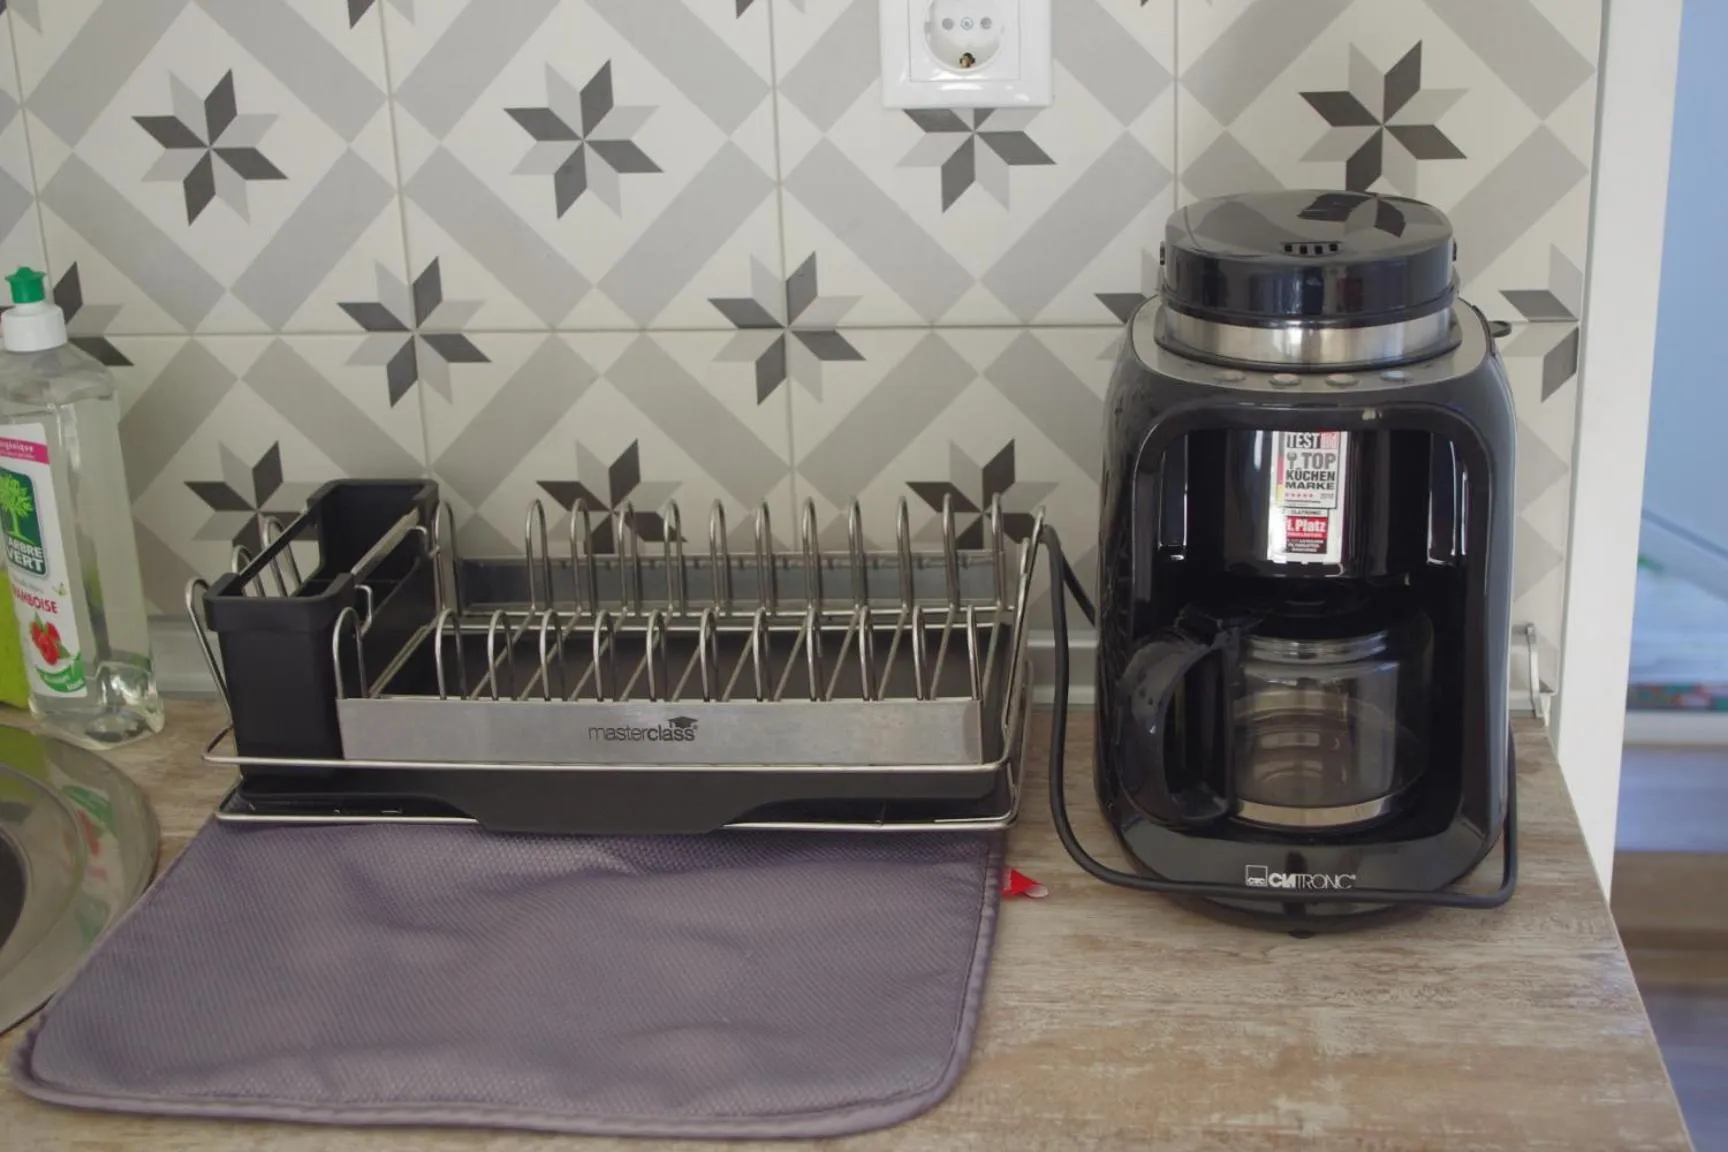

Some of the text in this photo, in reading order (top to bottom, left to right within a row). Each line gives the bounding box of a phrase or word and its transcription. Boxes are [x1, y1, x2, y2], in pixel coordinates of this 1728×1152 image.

[1286, 432, 1320, 448] TEST
[1302, 452, 1336, 470] TOP
[1286, 468, 1335, 481] KÜCHEN
[1285, 482, 1335, 490] MARKE
[8, 549, 45, 574] VERT
[588, 724, 696, 742] masterclass
